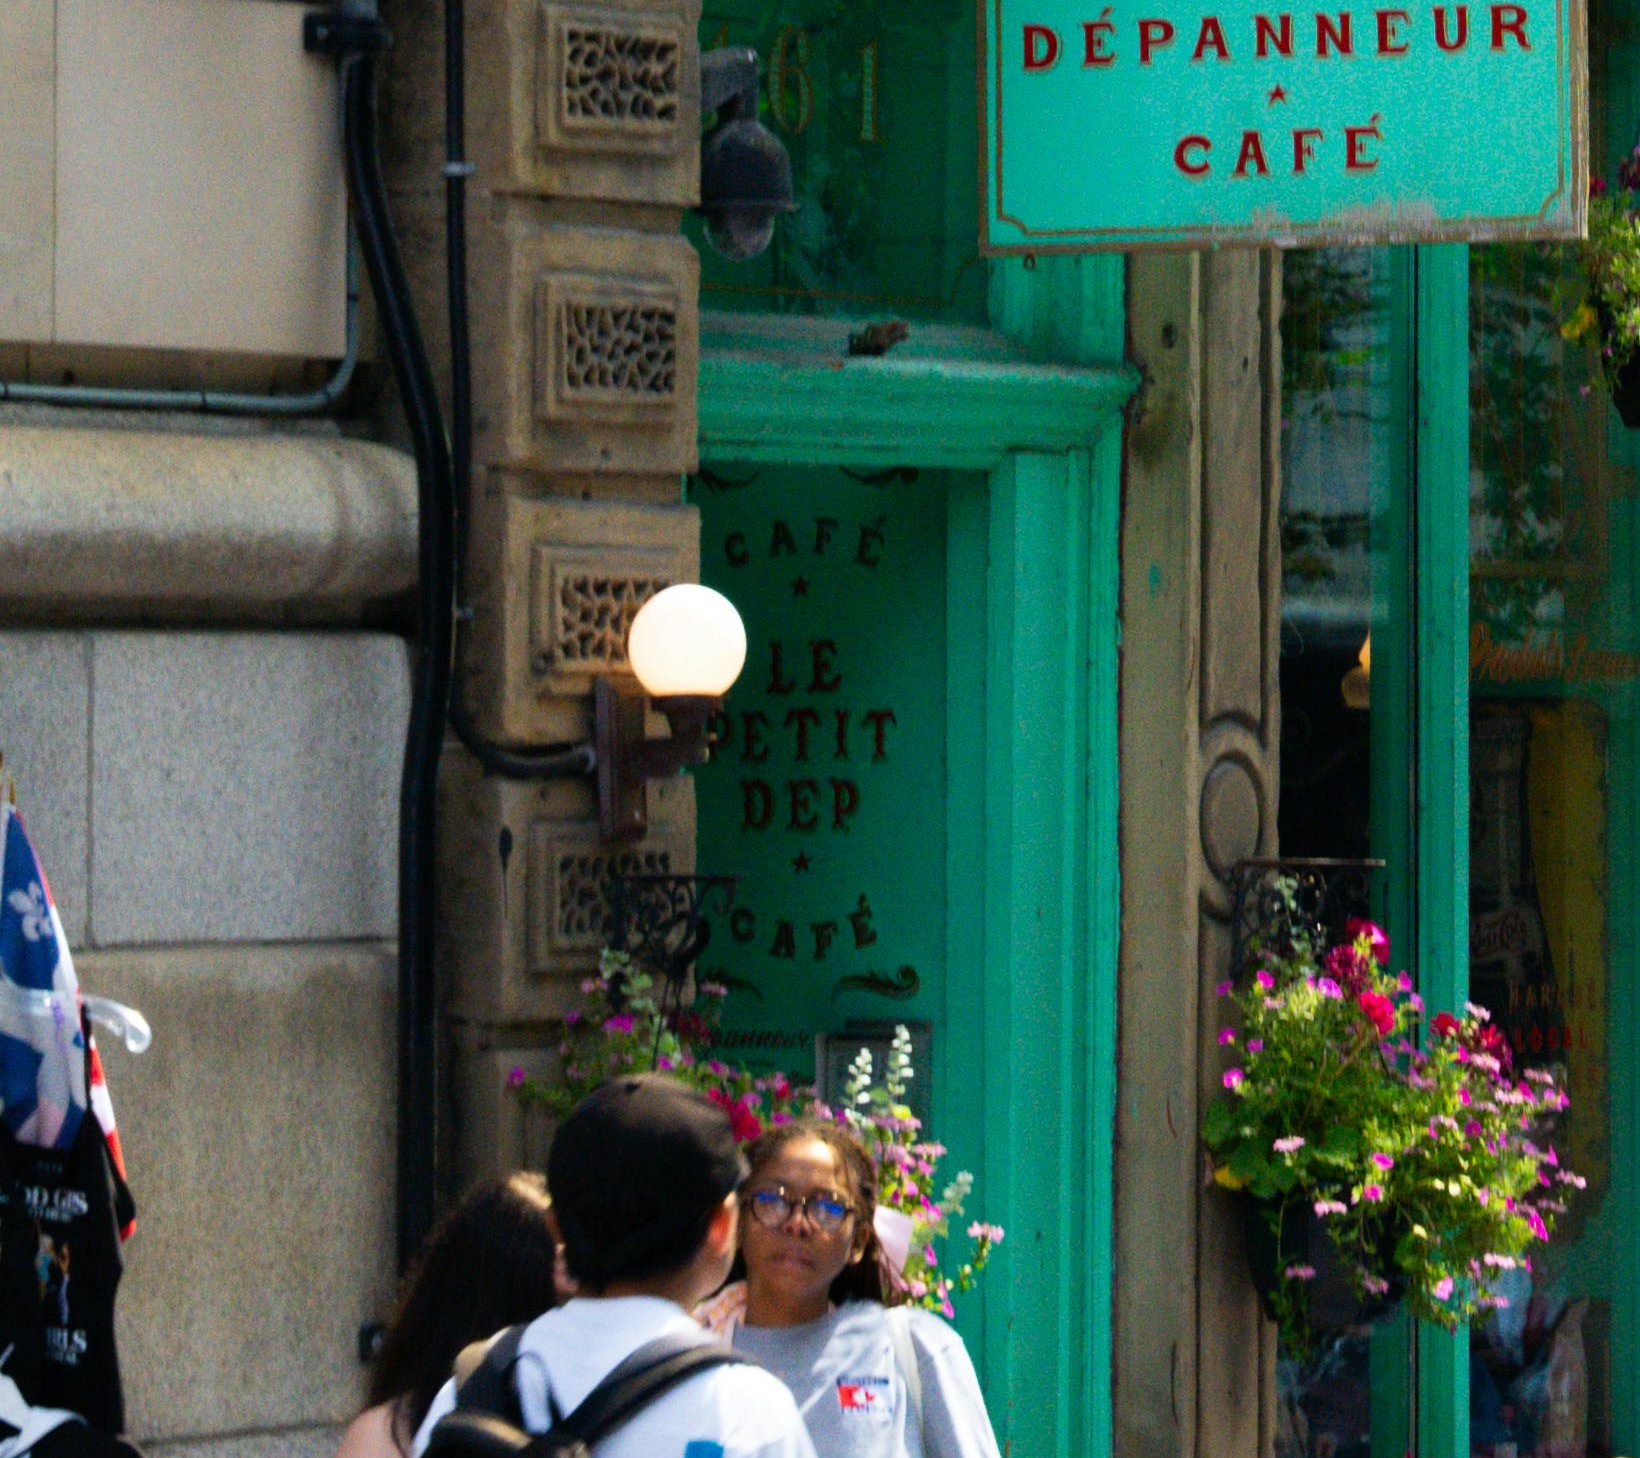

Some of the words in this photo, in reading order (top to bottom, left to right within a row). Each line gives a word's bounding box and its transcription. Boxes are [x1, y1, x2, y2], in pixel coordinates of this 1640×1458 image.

[1020, 3, 1532, 71] DÉPANNEUR
[703, 23, 883, 143] 61
[1173, 112, 1386, 176] CAFÉ
[722, 515, 887, 569] CAFÉ
[768, 638, 843, 694] LE
[706, 708, 897, 764] PETIT
[740, 778, 861, 833] DEP
[729, 892, 878, 962] CAFÉ
